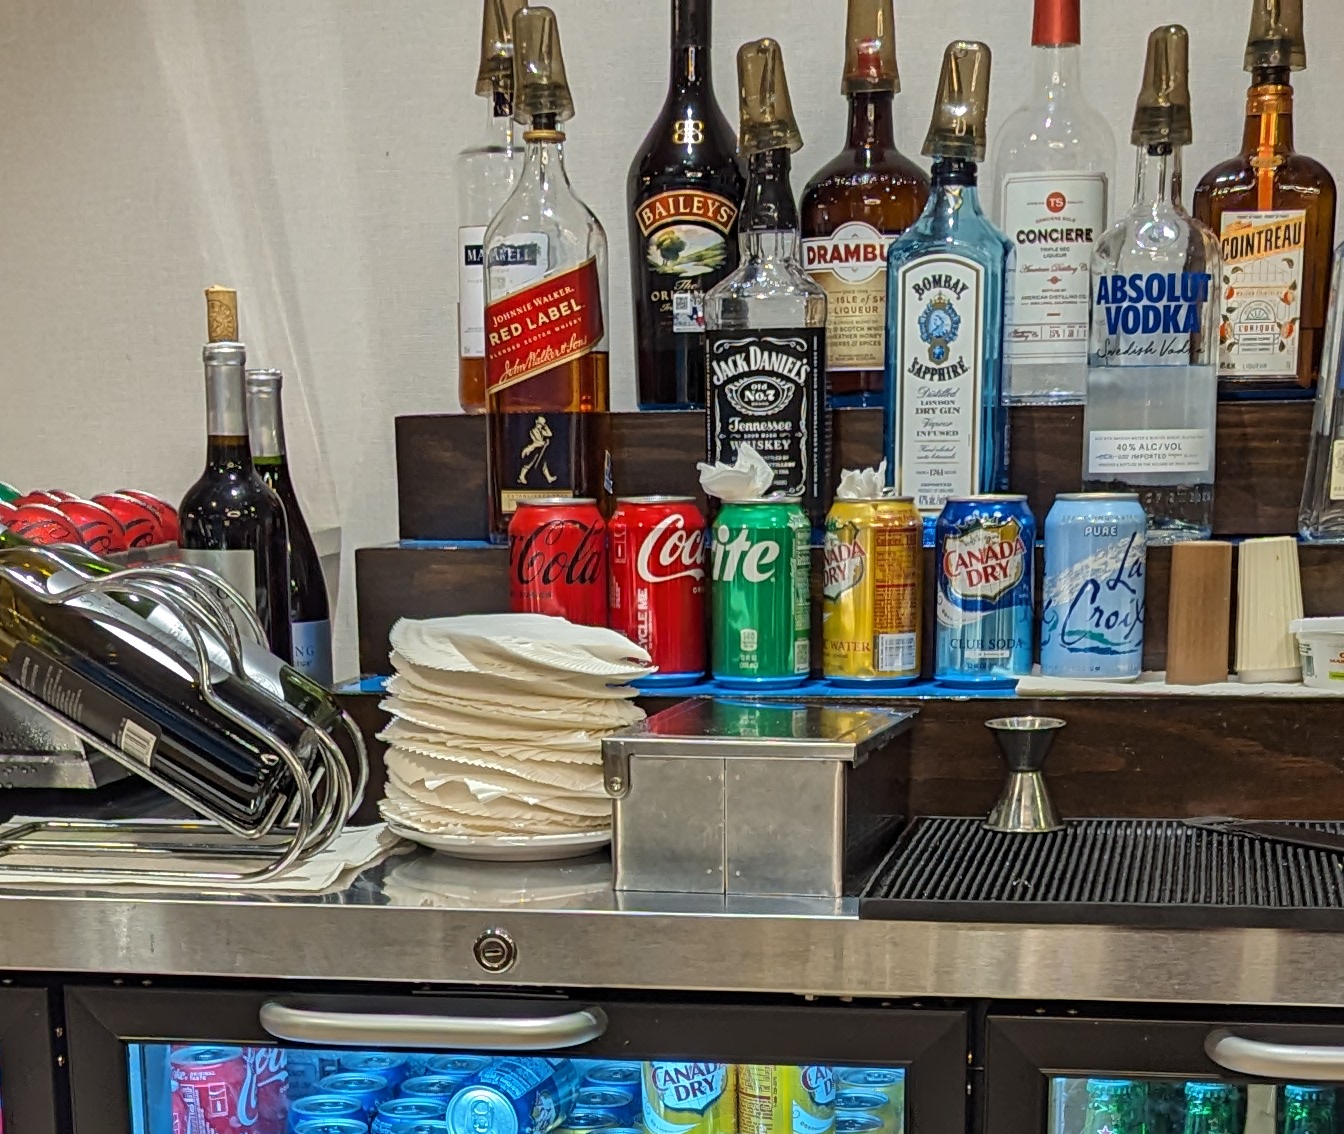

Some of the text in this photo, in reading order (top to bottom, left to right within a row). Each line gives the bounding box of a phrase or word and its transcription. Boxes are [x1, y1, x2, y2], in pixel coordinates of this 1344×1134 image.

[641, 195, 729, 224] BAILEYS
[1049, 197, 1064, 207] TS
[1016, 228, 1093, 244] CONCIERE
[1221, 221, 1302, 262] COINTREAU
[674, 279, 697, 290] The
[912, 274, 969, 301] BOMBAY
[1096, 272, 1211, 305] ABSOLUT
[834, 305, 879, 315] LIQUEUR
[836, 296, 858, 304] ISLE
[488, 298, 585, 347] RED LABEL
[493, 302, 532, 327] JOHNNIE
[1106, 303, 1202, 335] VODKA
[1096, 338, 1157, 359] Swedish
[712, 346, 811, 386] JACK DANIEL'S
[907, 355, 968, 382] SAPPHIRE
[744, 390, 776, 402] No.7
[915, 407, 961, 415] DRY GIN
[728, 417, 793, 433] Tennessee
[1116, 441, 1183, 452] 40% ALC/VOL
[1083, 525, 1118, 537] PURE
[943, 536, 1027, 579] CANADA
[1106, 531, 1144, 595] La
[965, 562, 1011, 588] DRY
[1060, 578, 1144, 646] Croix
[831, 641, 871, 653] WATER
[950, 637, 1023, 650] CLUB SODA
[674, 1075, 717, 1102] DRY
